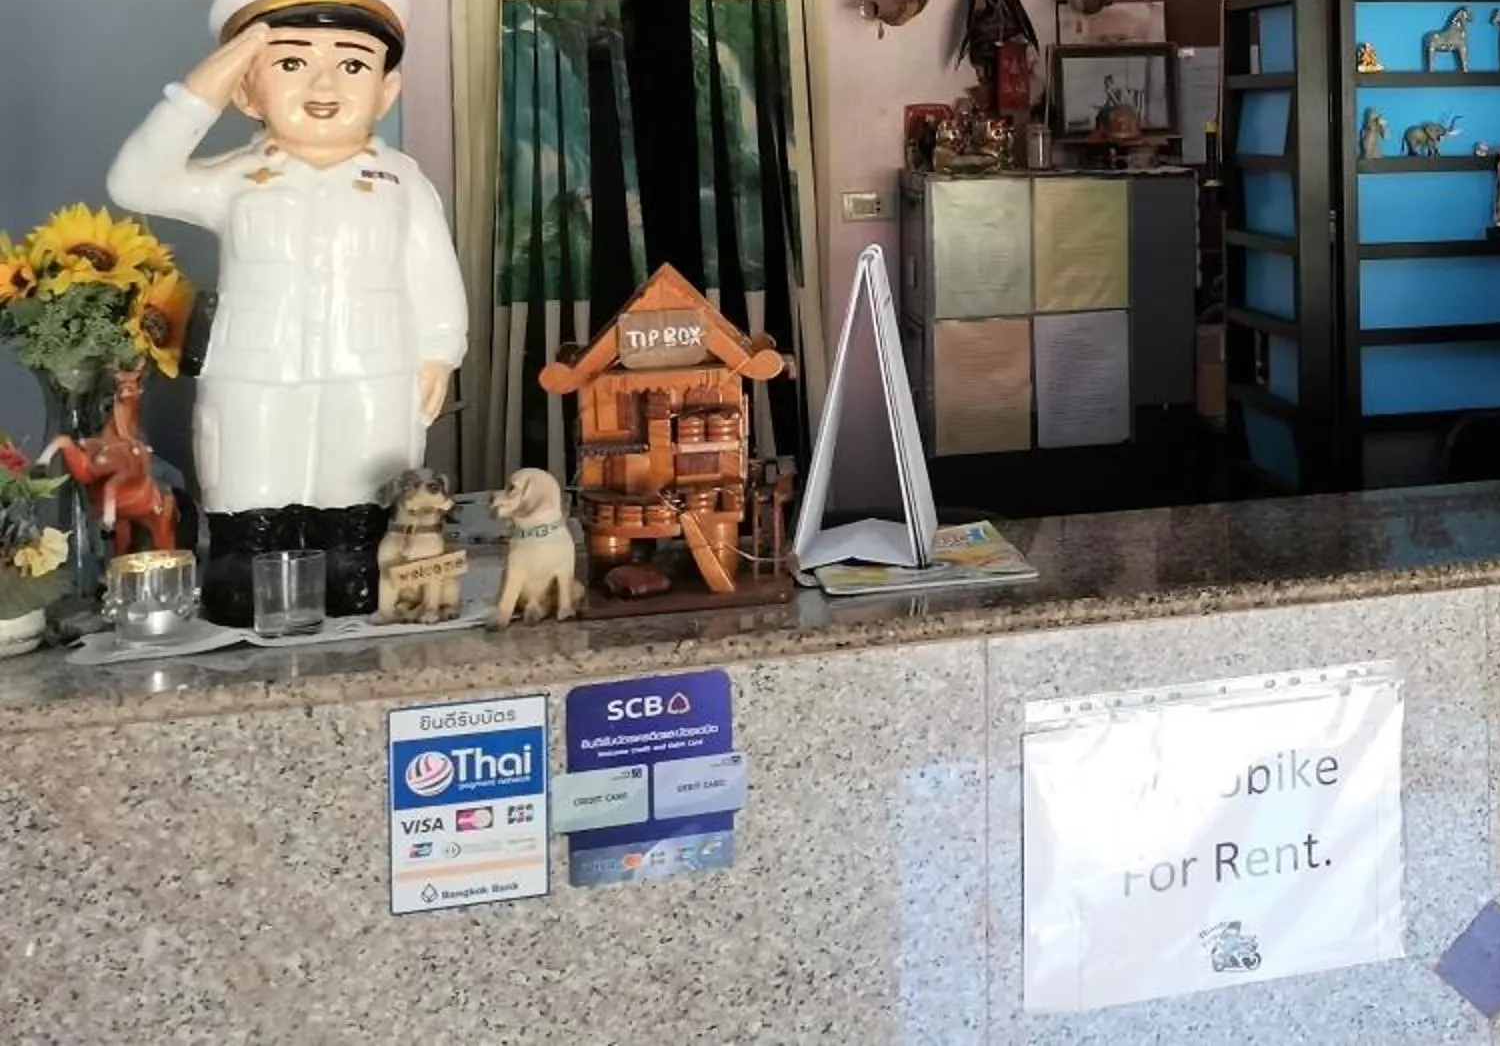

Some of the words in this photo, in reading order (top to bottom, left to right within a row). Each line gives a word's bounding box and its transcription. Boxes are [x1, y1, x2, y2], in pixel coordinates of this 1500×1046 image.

[626, 329, 659, 349] TIP
[663, 325, 702, 348] BOX
[607, 695, 663, 721] SCB
[451, 744, 532, 782] Thai
[401, 817, 445, 835] VISA
[1214, 832, 1332, 883] Rent.
[442, 886, 488, 899] Bangkok
